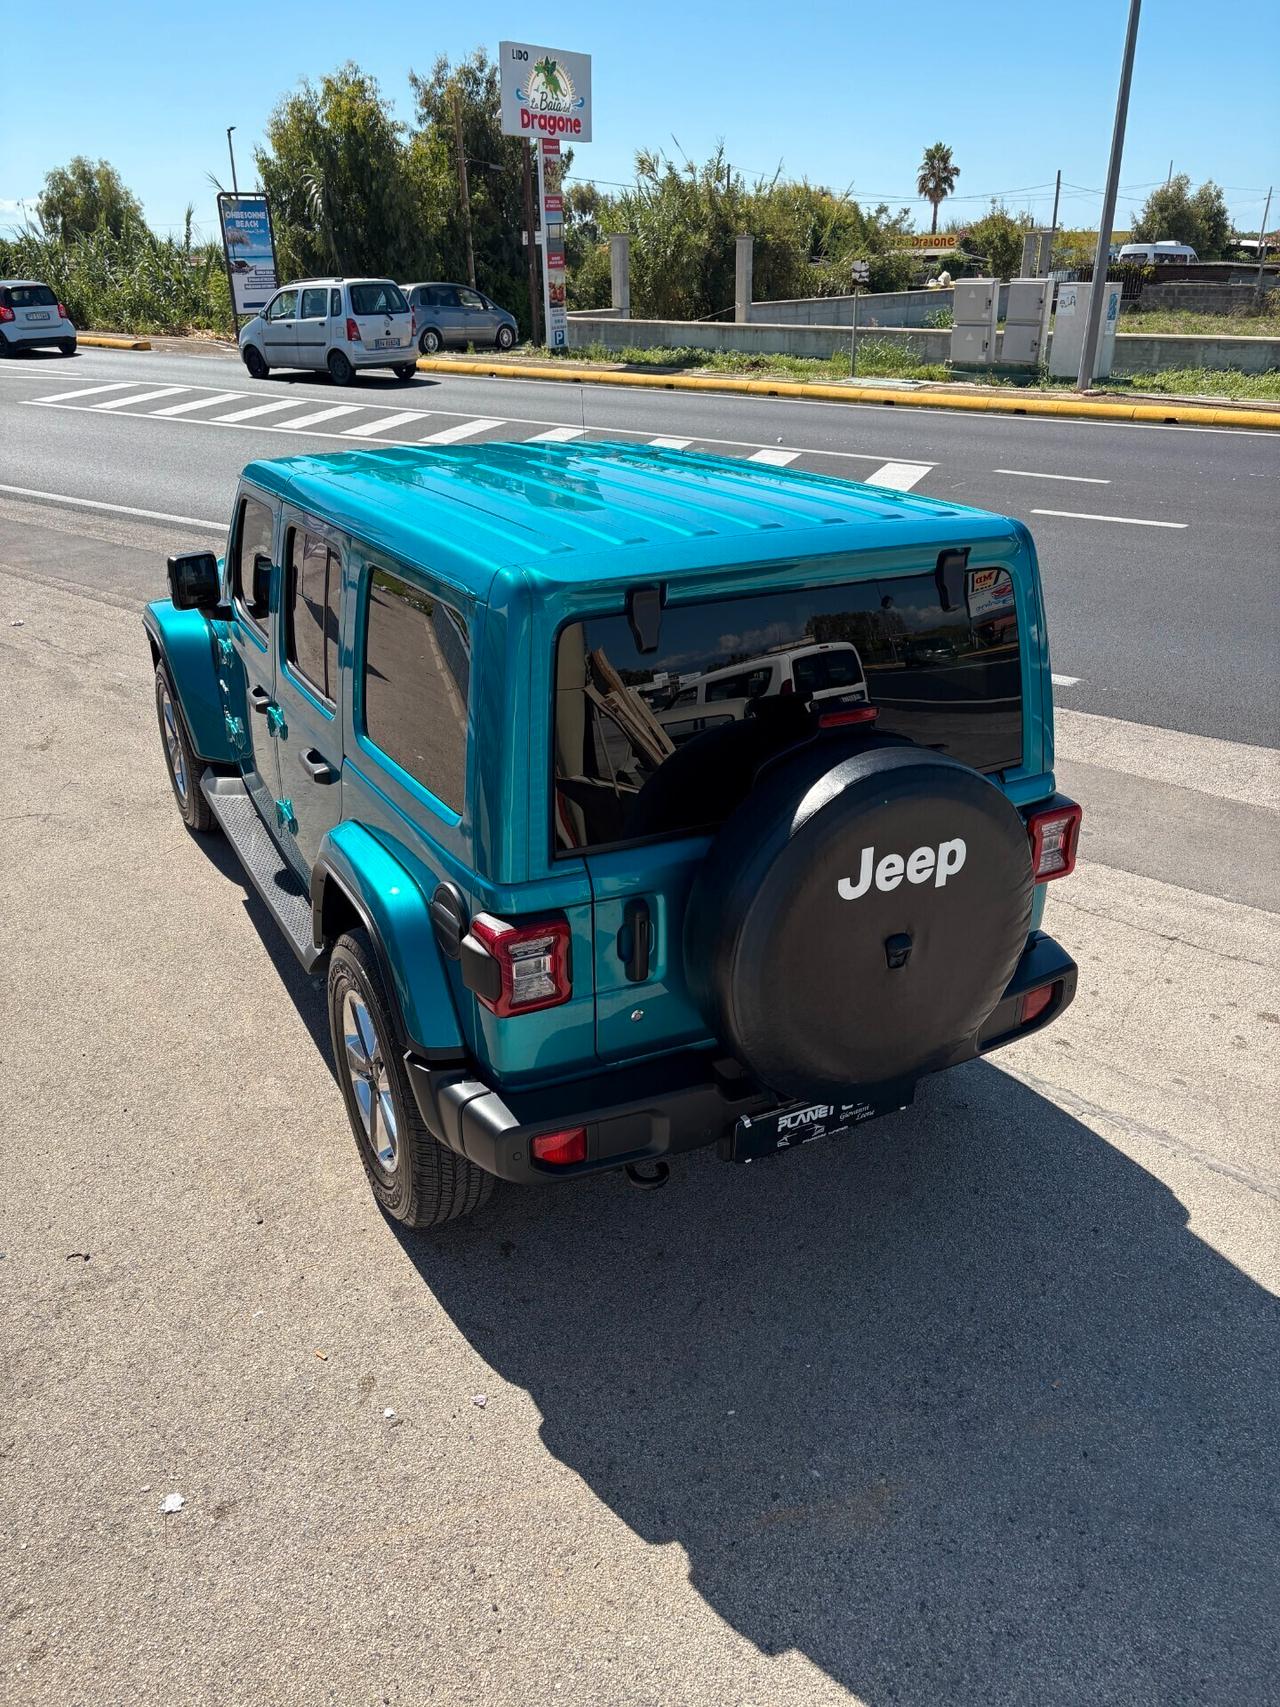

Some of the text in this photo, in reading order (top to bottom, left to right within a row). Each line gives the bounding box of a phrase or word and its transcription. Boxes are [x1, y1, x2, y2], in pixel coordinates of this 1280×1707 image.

[511, 48, 529, 61] LIDO
[539, 91, 561, 112] Baia
[520, 108, 582, 136] Dragone
[235, 219, 259, 228] BEACH
[556, 330, 563, 344] P
[837, 838, 967, 900] Jeep
